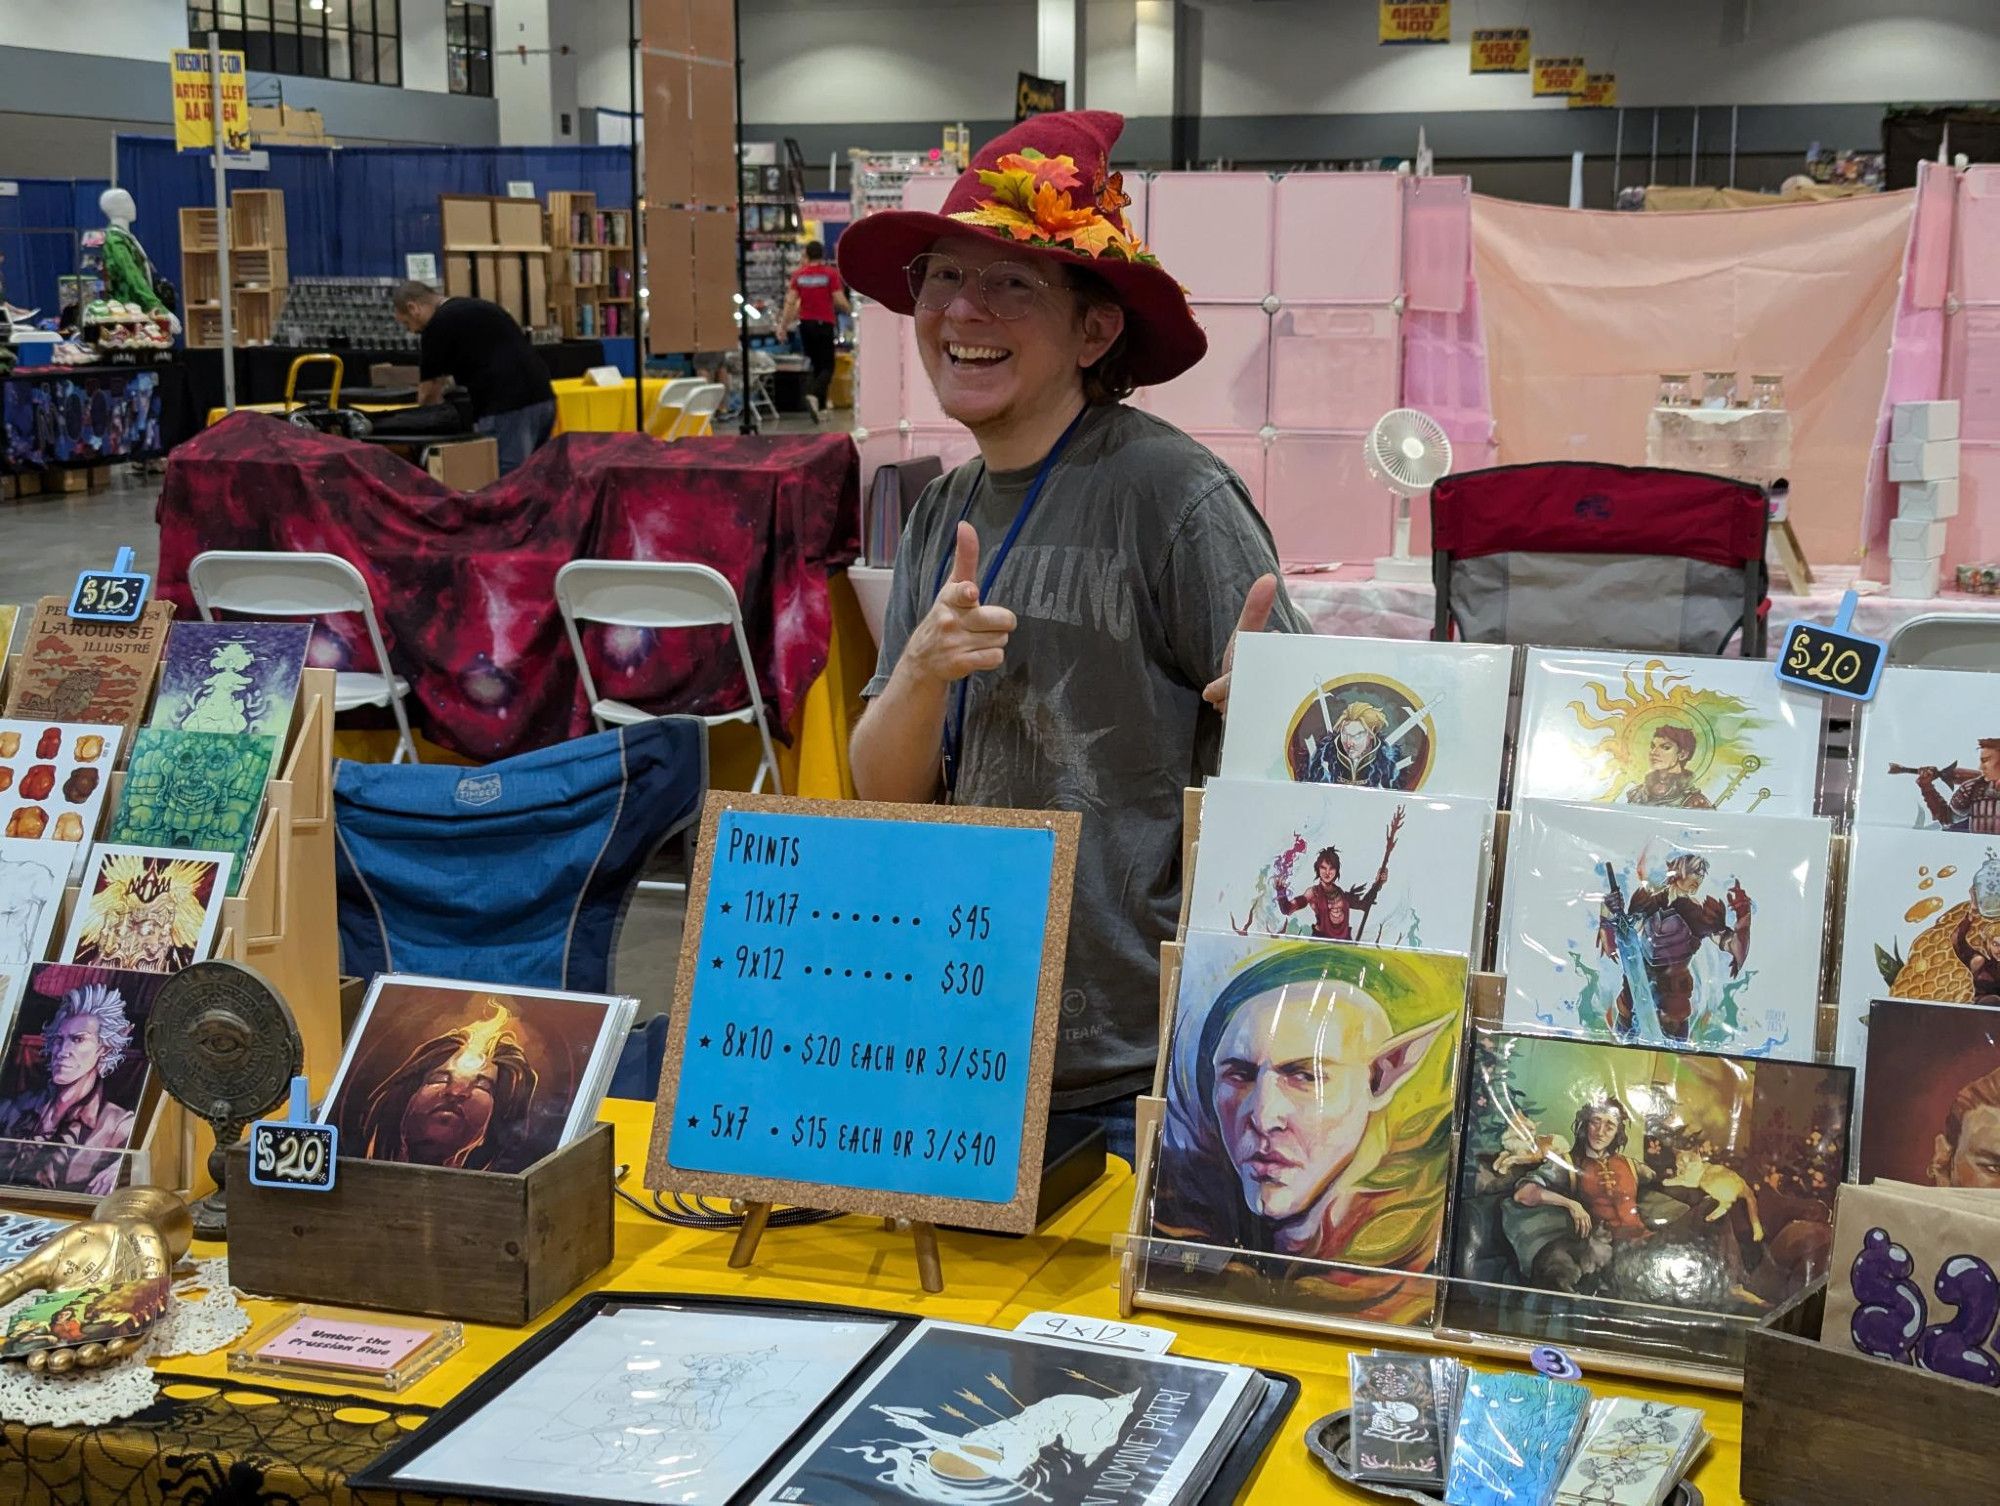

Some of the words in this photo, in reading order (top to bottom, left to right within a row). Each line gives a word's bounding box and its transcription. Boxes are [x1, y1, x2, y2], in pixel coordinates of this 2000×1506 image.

[1391, 6, 1441, 20] AISLE
[1396, 20, 1434, 33] 400
[81, 577, 129, 610] $15
[39, 620, 155, 640] LAROUSSE
[1788, 631, 1861, 684] $20
[745, 890, 800, 926] 11x17
[949, 904, 991, 940] $45
[736, 945, 785, 980] 9x12
[941, 961, 984, 997] $30
[722, 1022, 773, 1060] 8x10
[801, 1033, 841, 1067] $20
[851, 1042, 895, 1071] EACH
[936, 1045, 1007, 1082] 3/$50
[257, 1129, 324, 1180] $20
[711, 1104, 749, 1141] 5x7
[792, 1114, 827, 1149] $15
[838, 1124, 881, 1154] EACH
[924, 1128, 996, 1166] 3/$40
[288, 1337, 353, 1353] Prussian
[356, 1346, 390, 1356] Blue
[366, 1336, 392, 1347] the
[1543, 1350, 1567, 1375] 3
[1093, 1433, 1162, 1494] NOMINE
[1134, 1387, 1191, 1432] PATRI
